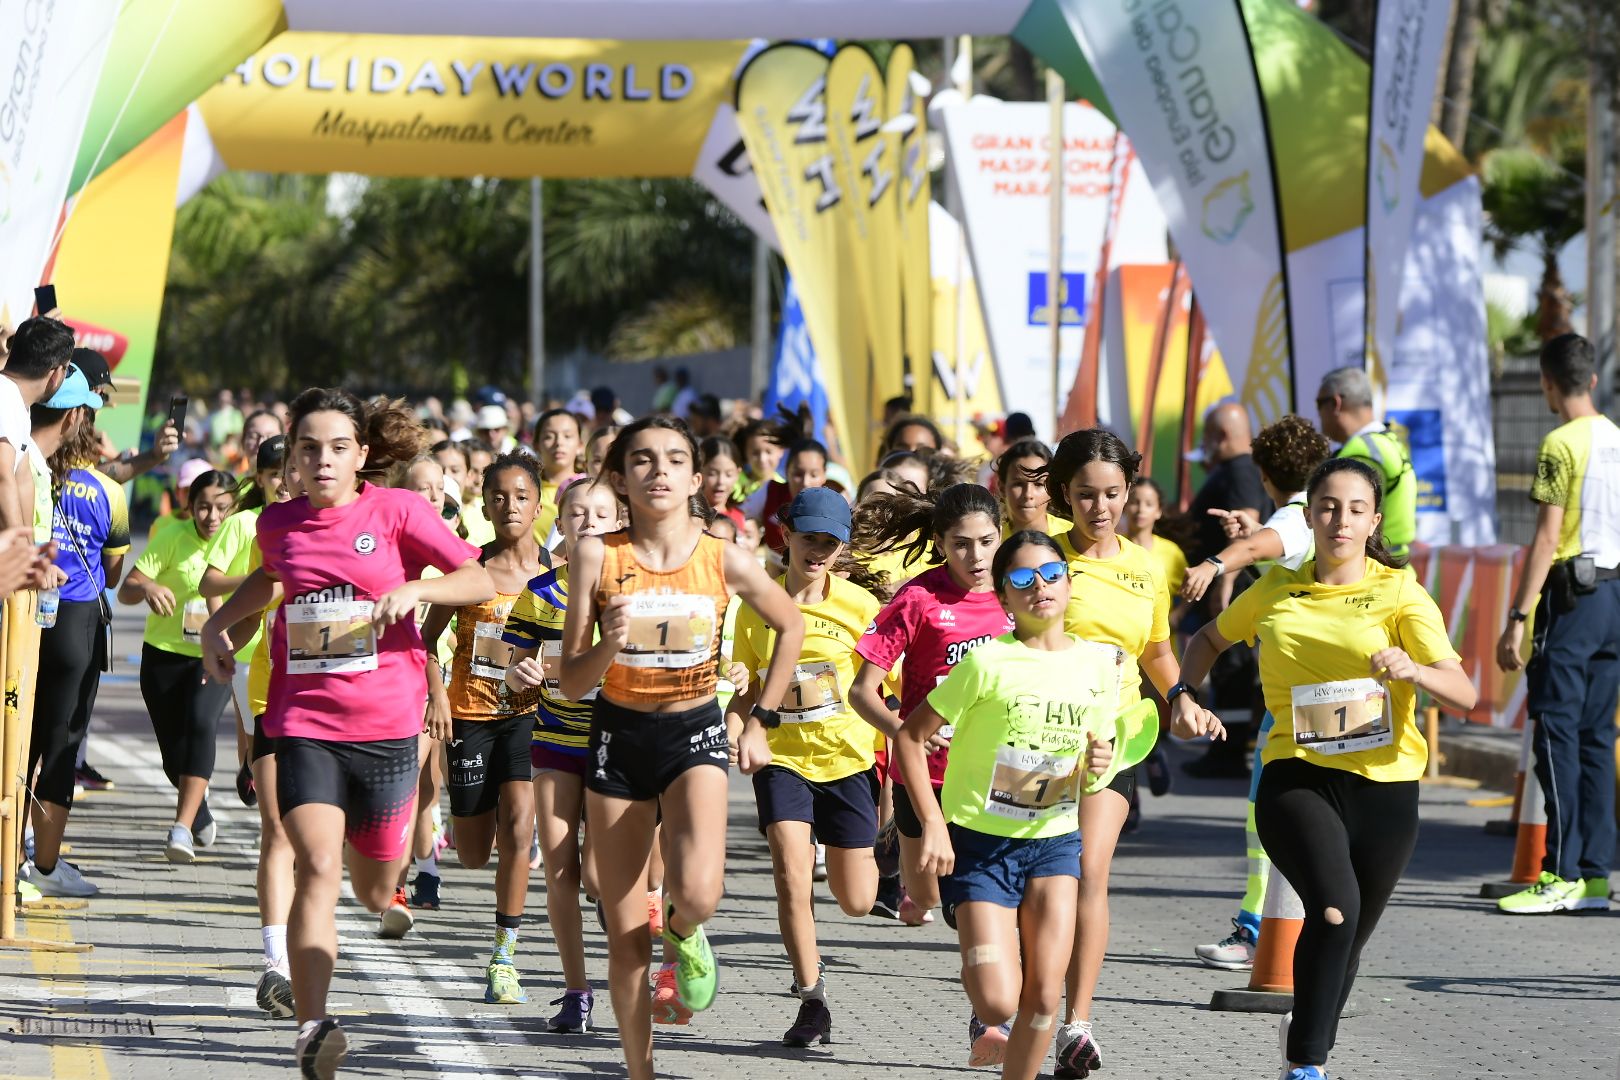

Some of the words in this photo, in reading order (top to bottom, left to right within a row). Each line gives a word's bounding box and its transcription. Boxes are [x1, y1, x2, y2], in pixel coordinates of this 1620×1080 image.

[311, 107, 494, 145] Maspalomas
[502, 113, 596, 145] Center
[971, 134, 1033, 151] GRAN
[319, 626, 330, 652] 1
[656, 621, 669, 646] 1
[791, 685, 803, 707] 1
[1334, 705, 1347, 733] 1
[1035, 778, 1050, 803] 1
